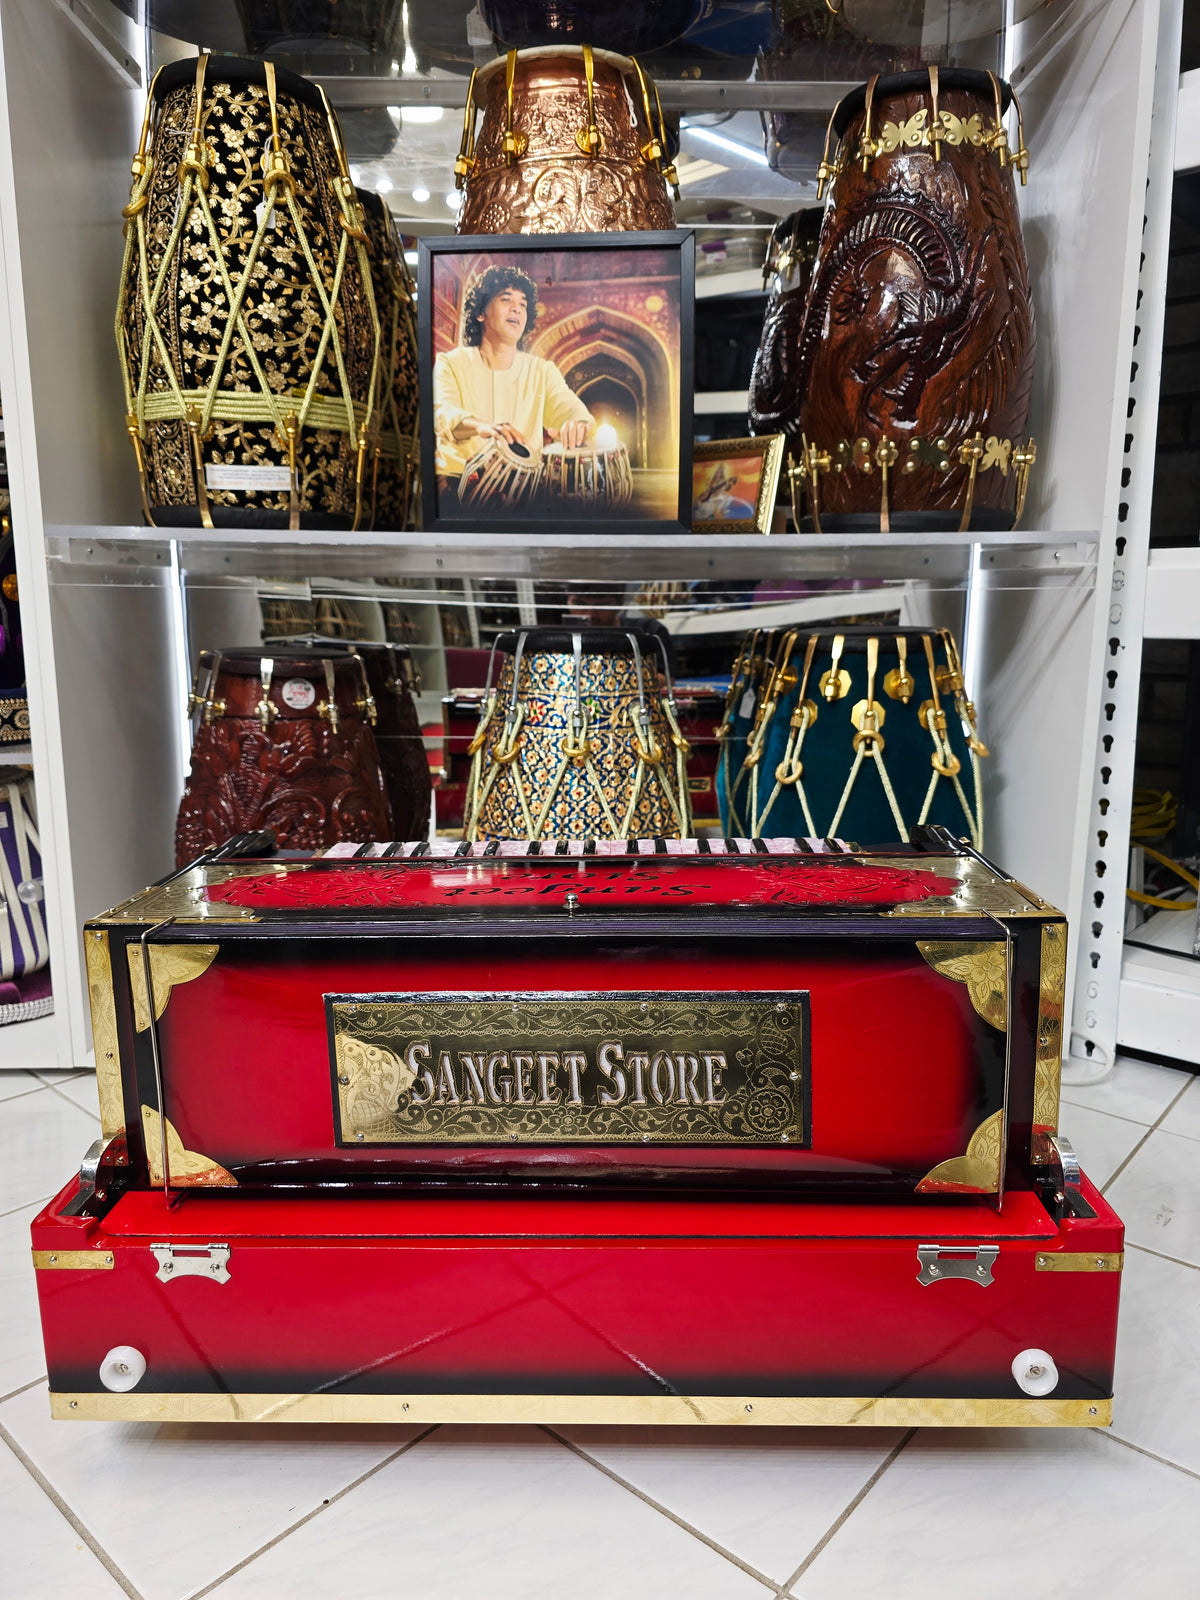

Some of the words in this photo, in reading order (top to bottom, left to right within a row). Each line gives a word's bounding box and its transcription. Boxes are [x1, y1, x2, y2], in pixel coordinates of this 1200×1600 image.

[501, 870, 674, 881] Store
[440, 883, 711, 897] Sangeet
[404, 1039, 588, 1106] SANGEET
[597, 1039, 729, 1106] STORE
